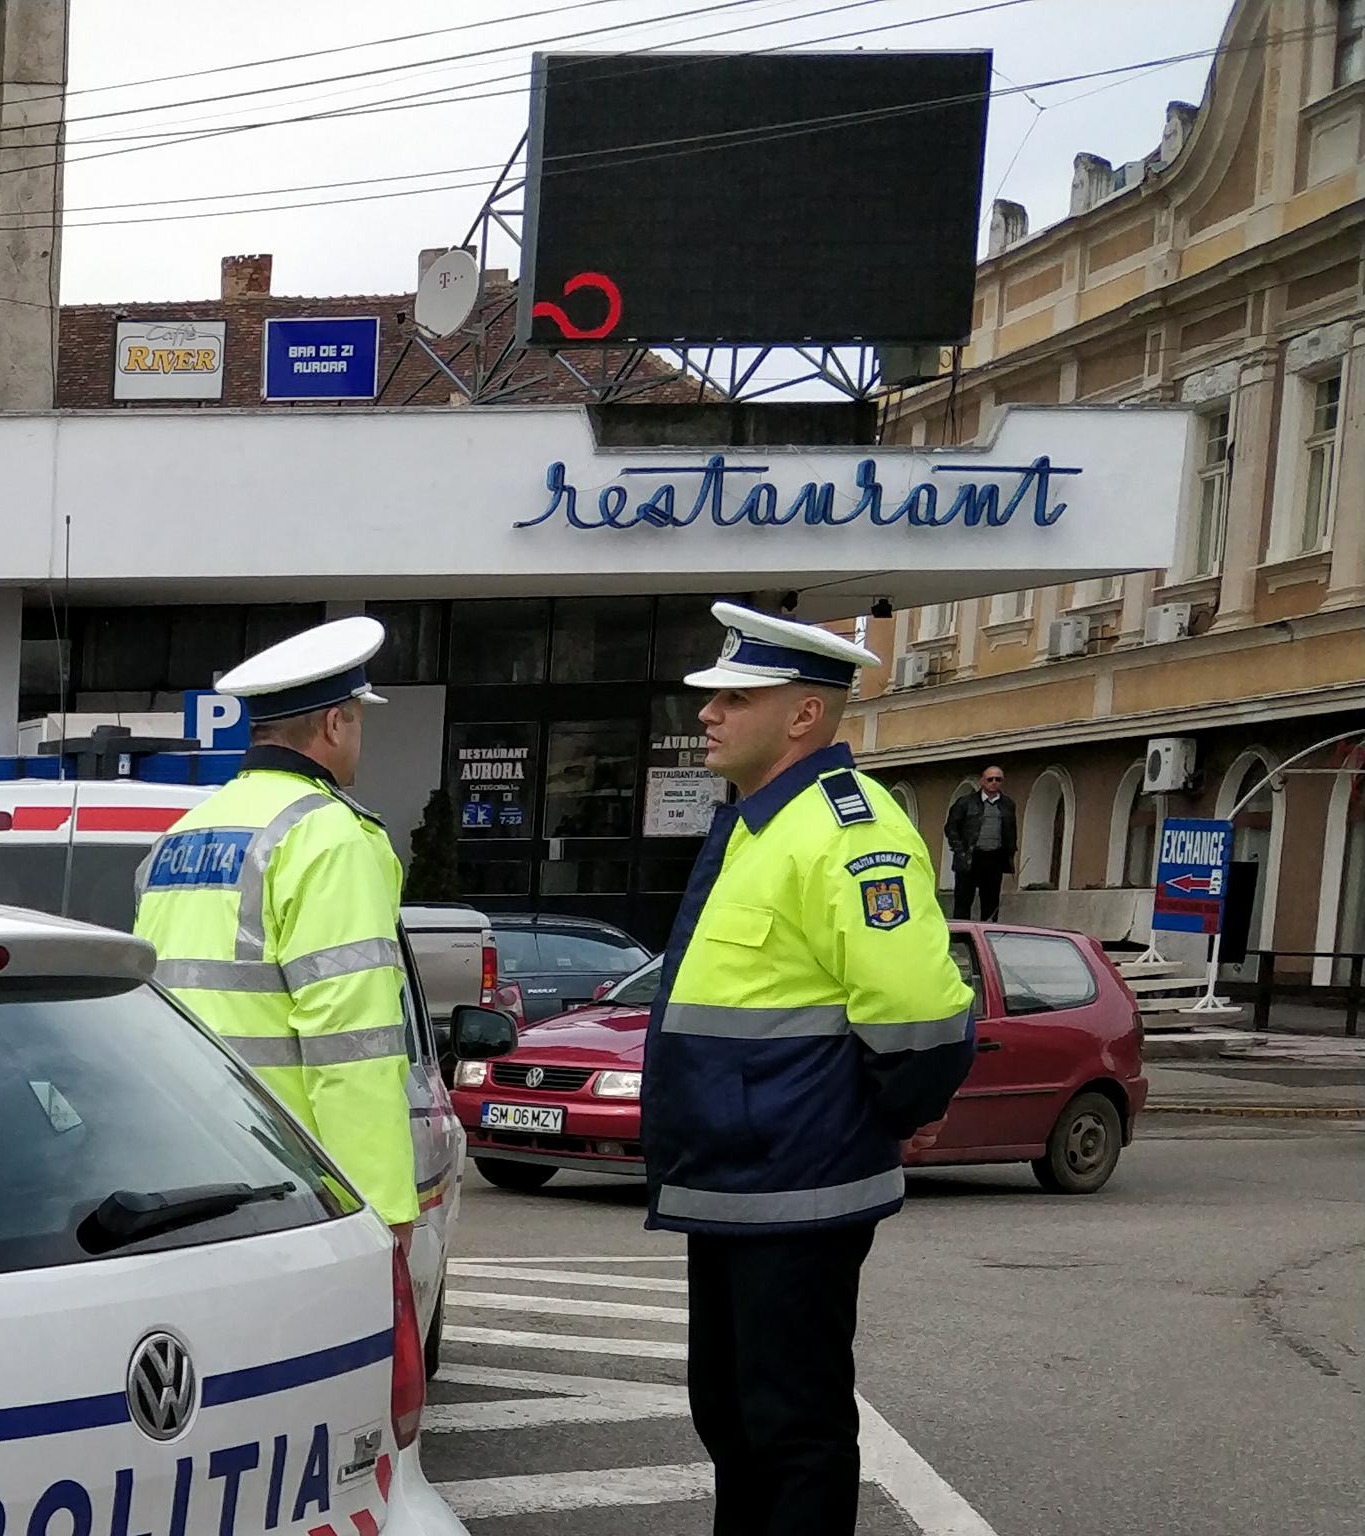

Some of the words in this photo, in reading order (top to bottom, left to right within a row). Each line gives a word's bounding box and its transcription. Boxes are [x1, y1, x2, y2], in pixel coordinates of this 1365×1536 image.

[124, 345, 216, 375] RIVER
[319, 345, 337, 357] DE
[340, 344, 354, 357] ZI
[293, 361, 348, 373] AURORA
[513, 454, 1084, 529] restaurant
[197, 695, 241, 748] P
[662, 735, 709, 749] AUROR
[459, 747, 529, 760] RESTAURANT
[460, 761, 525, 780] AURORA
[1161, 830, 1226, 866] EXCHANGE
[489, 1106, 509, 1124] SM
[513, 1107, 529, 1126] 06
[530, 1110, 561, 1129] MZY
